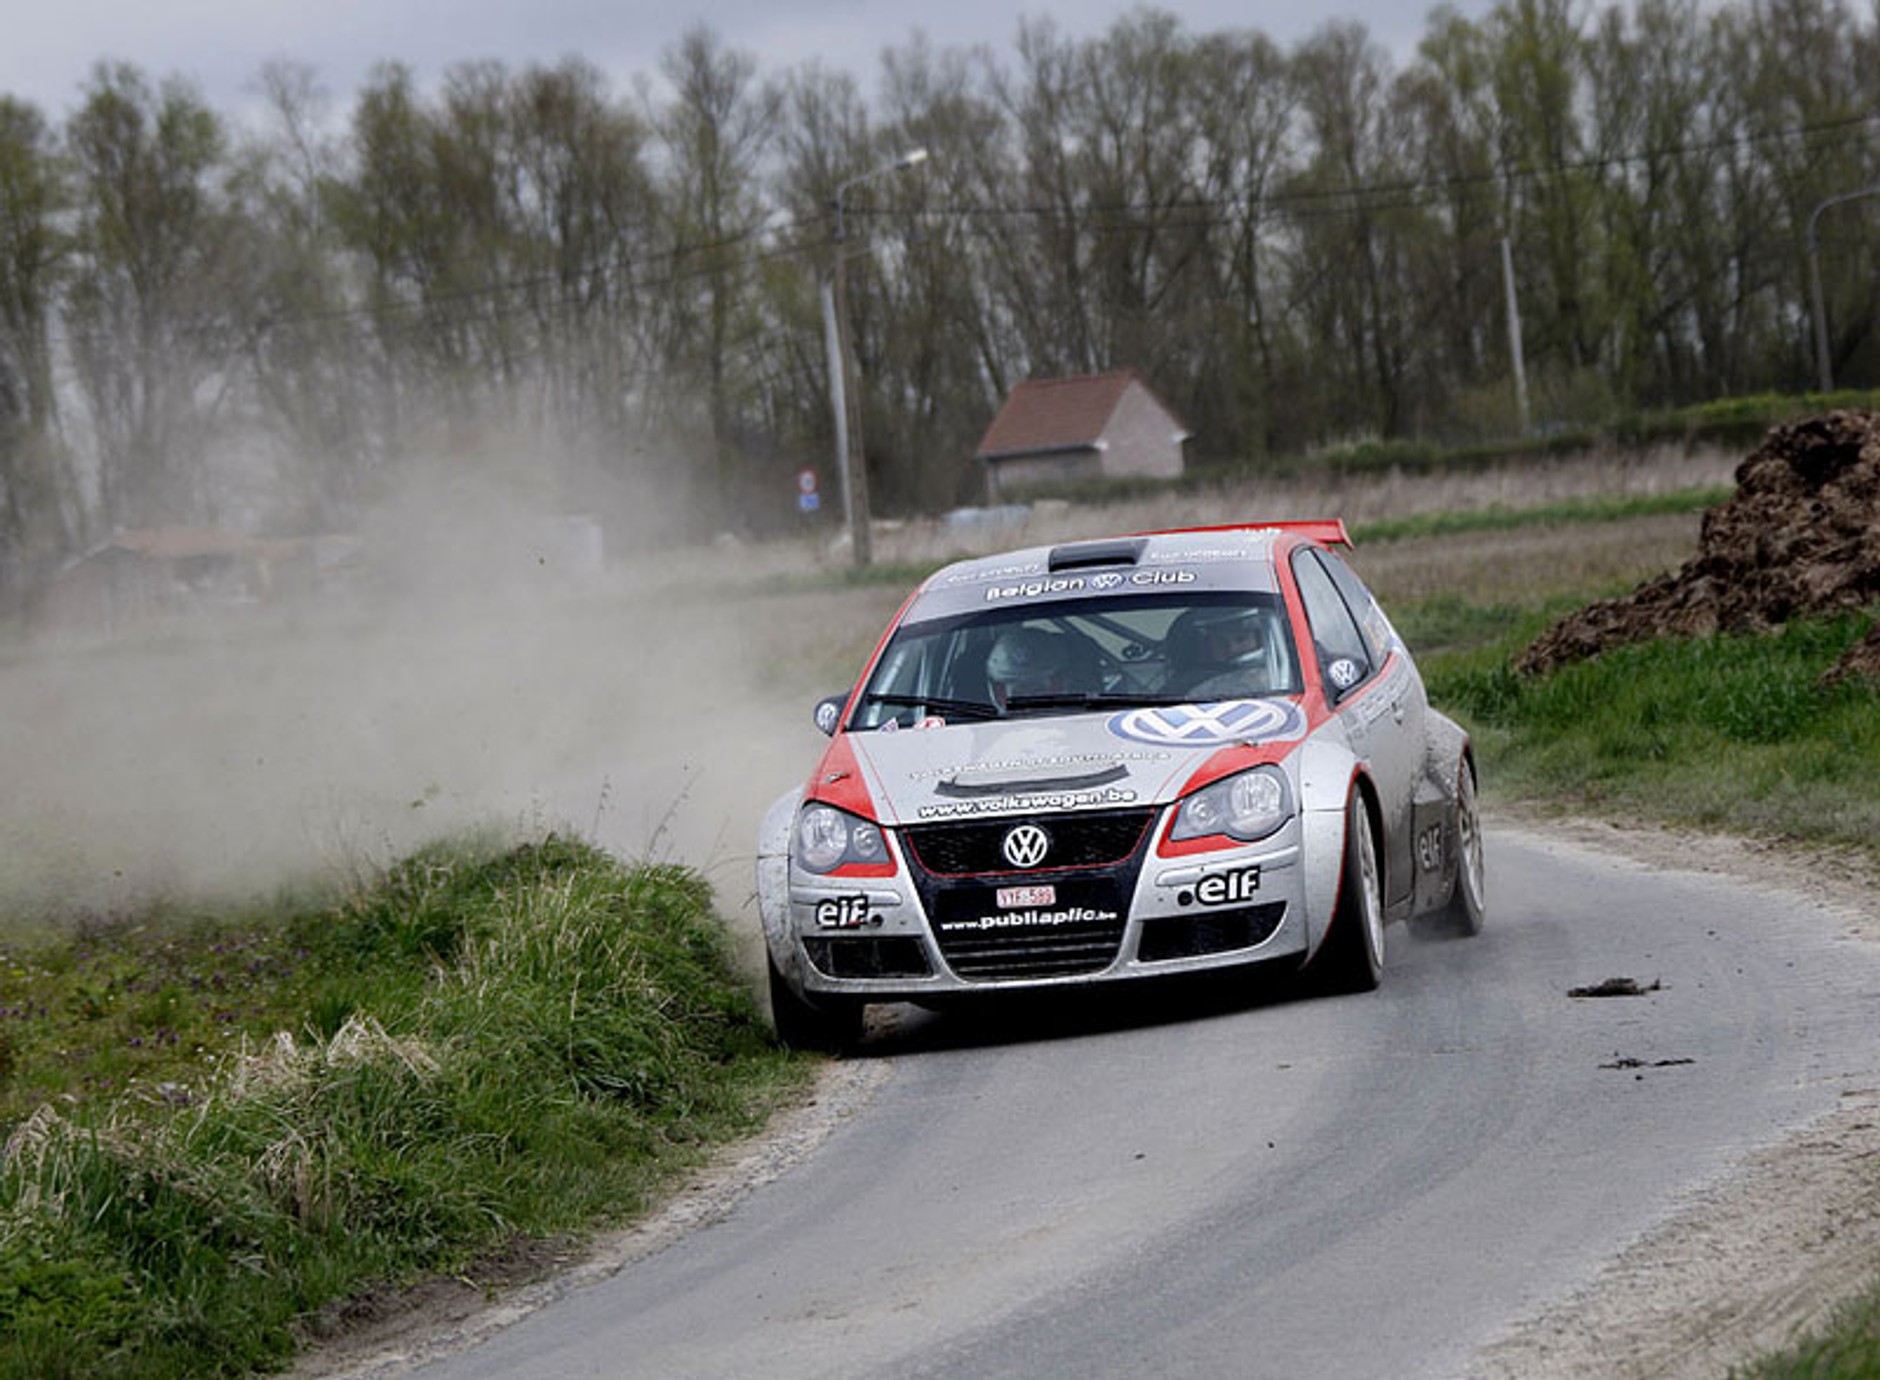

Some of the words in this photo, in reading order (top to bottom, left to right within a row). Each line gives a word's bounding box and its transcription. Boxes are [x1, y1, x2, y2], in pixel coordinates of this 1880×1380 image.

[985, 576, 1085, 600] Belgian
[1131, 570, 1197, 585] Club
[918, 787, 1137, 818] www.volkswagen.be
[1419, 826, 1440, 870] elf
[1197, 866, 1260, 904] elf
[817, 897, 867, 928] elf
